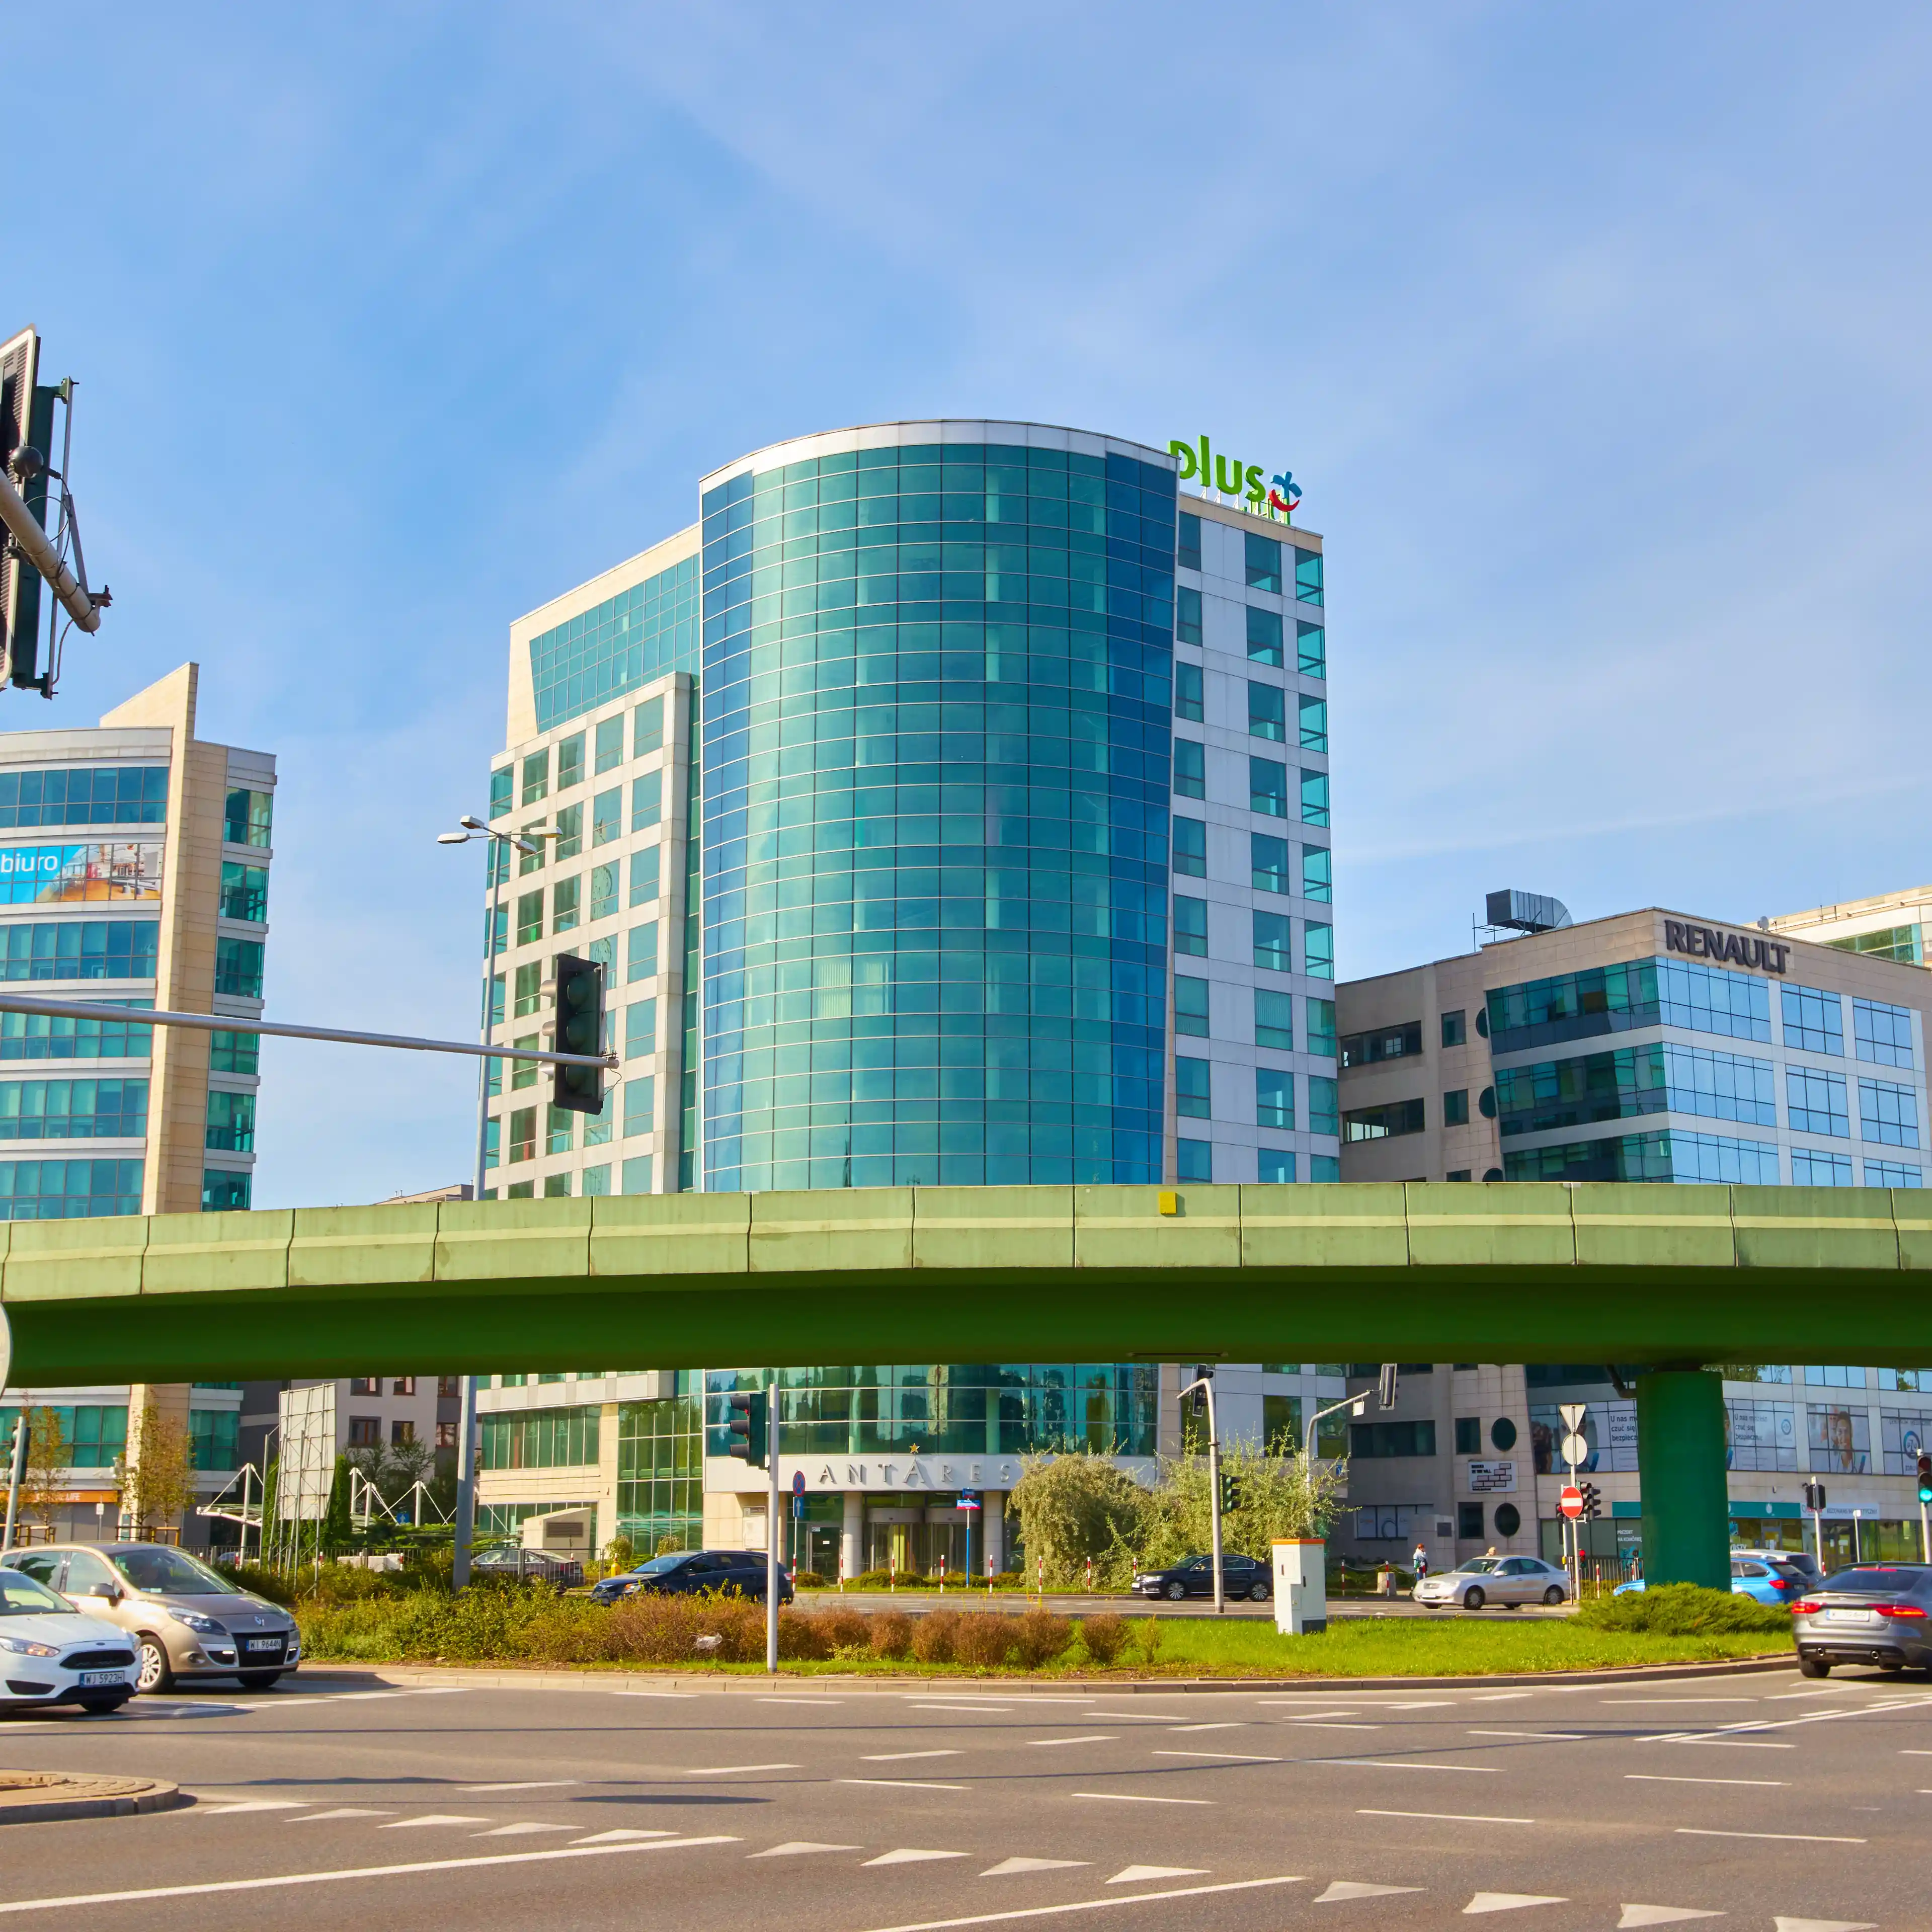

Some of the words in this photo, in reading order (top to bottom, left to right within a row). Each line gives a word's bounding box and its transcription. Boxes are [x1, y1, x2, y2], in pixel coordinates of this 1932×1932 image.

[1167, 435, 1266, 503] plus
[1, 853, 58, 872] biuro
[1664, 920, 1791, 974] RENAULT
[819, 1459, 1010, 1483] ANTARES
